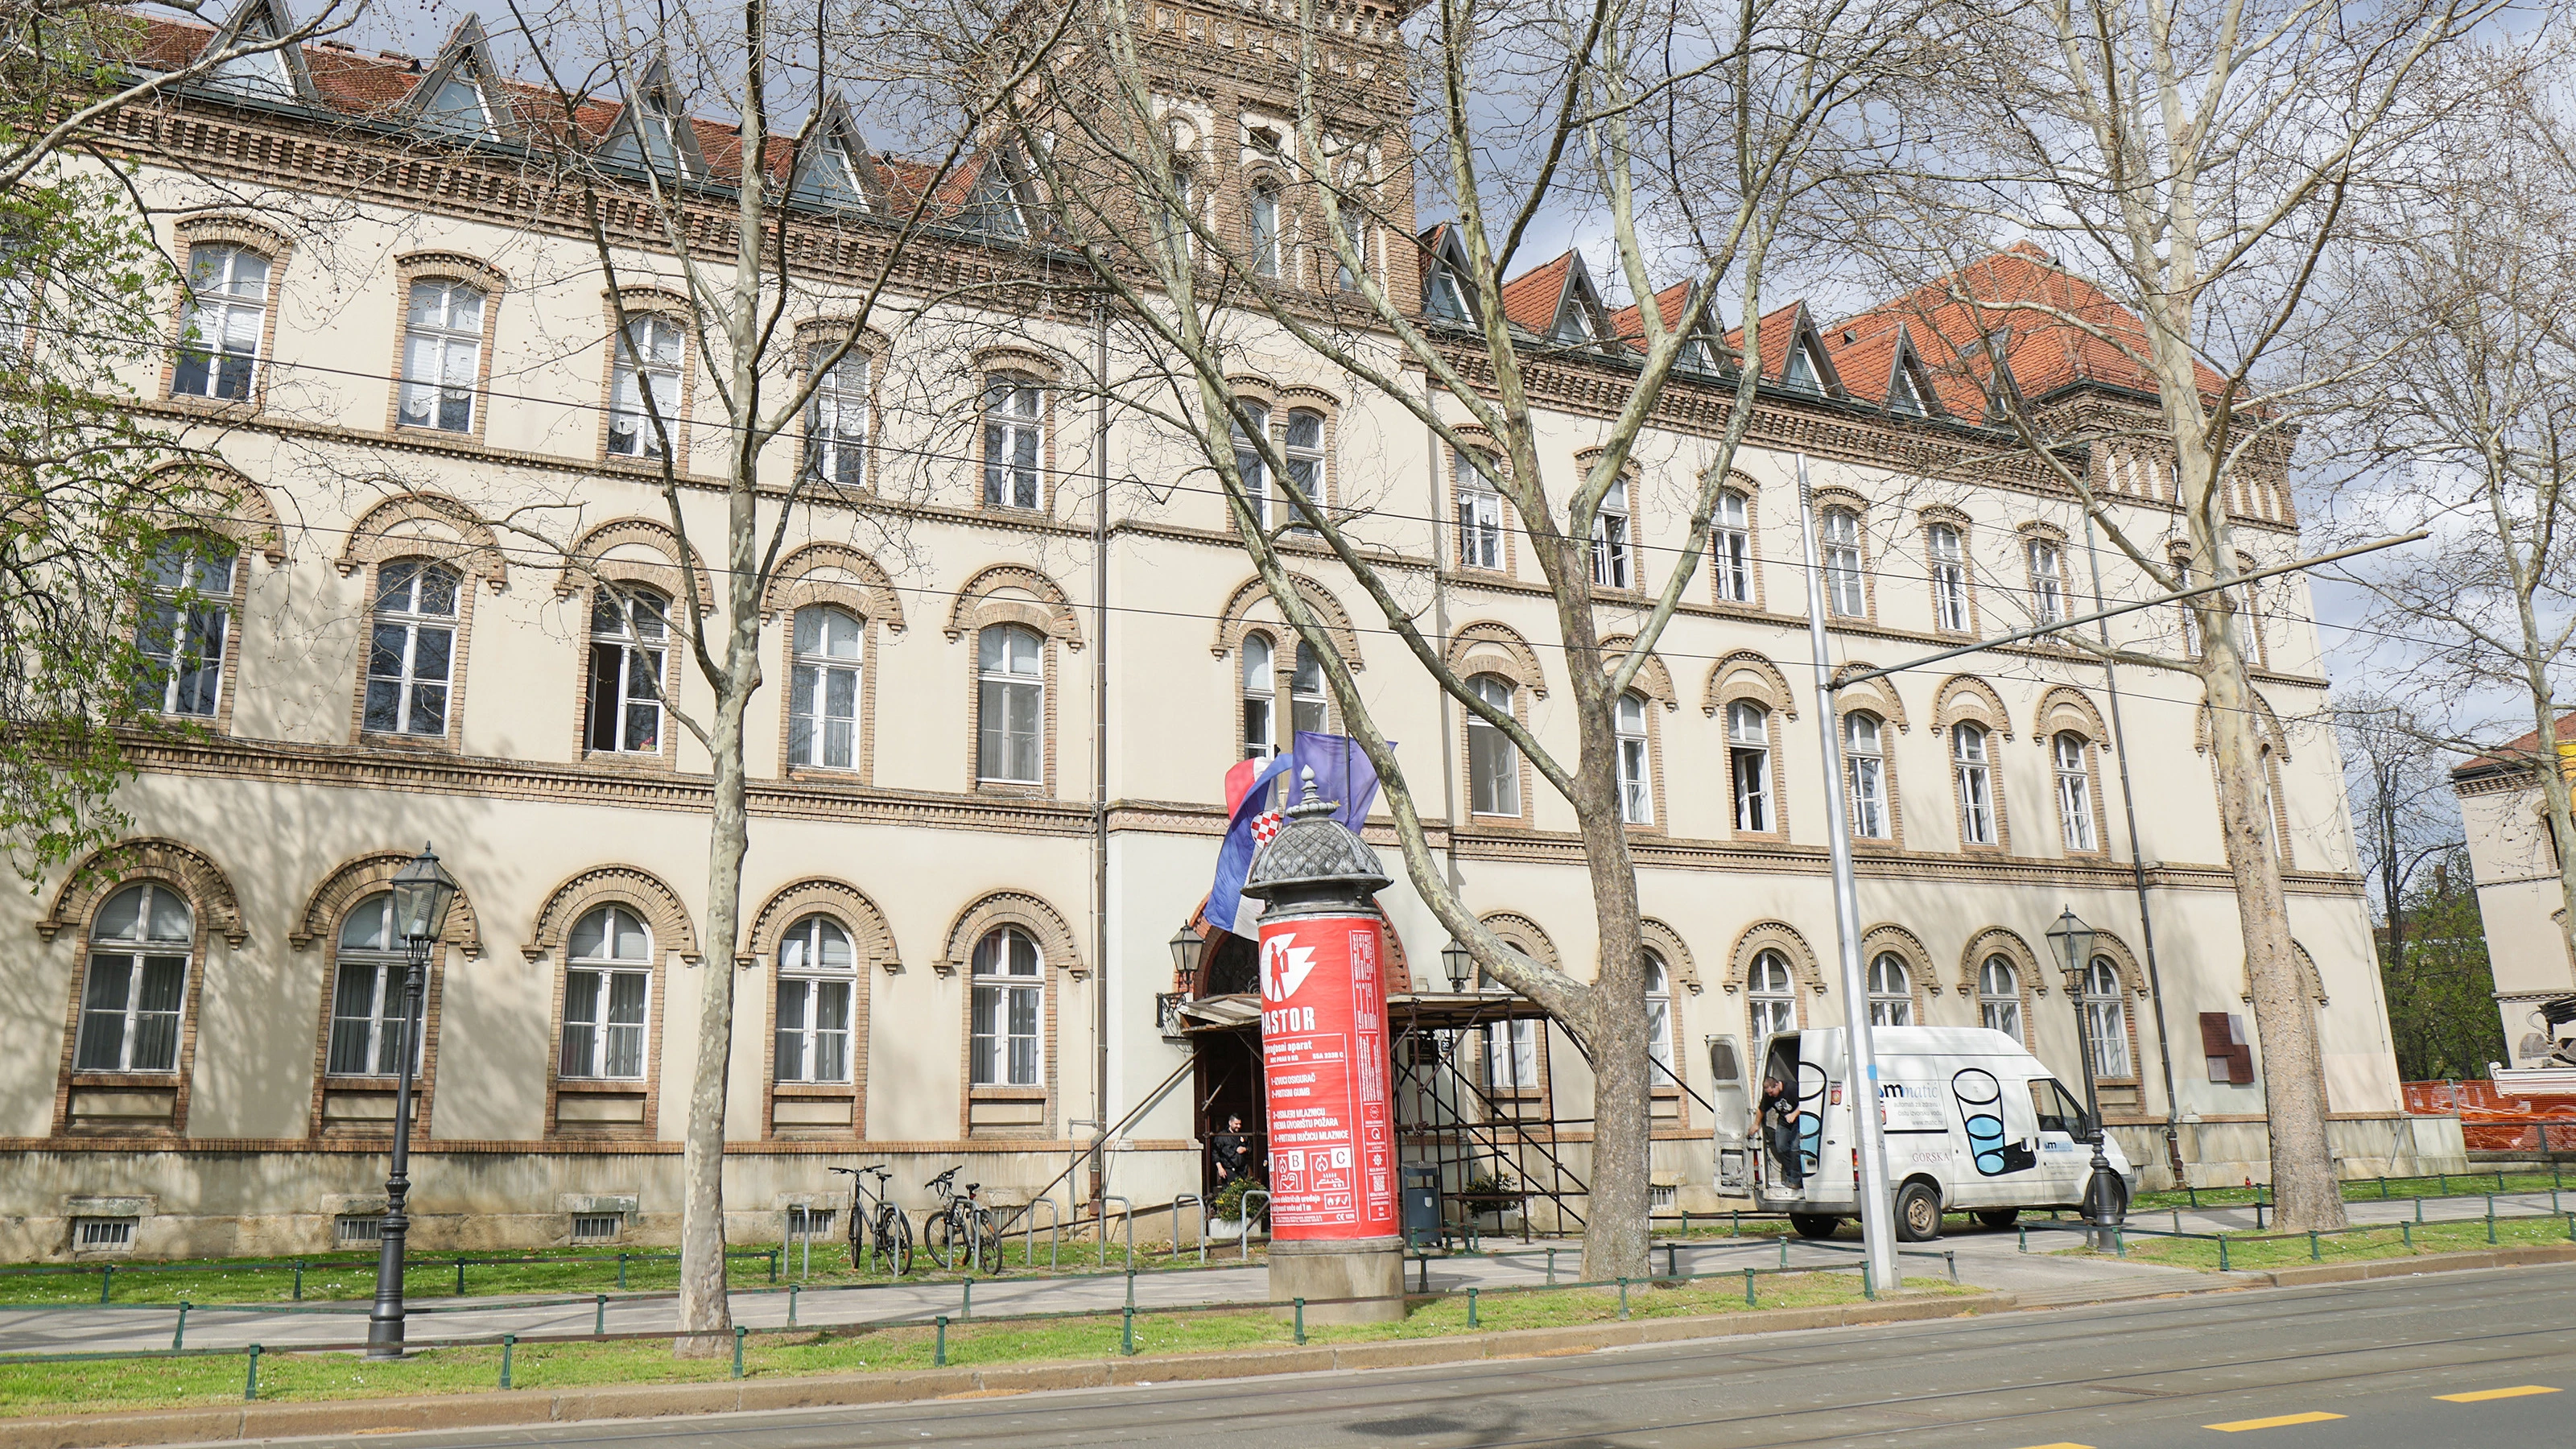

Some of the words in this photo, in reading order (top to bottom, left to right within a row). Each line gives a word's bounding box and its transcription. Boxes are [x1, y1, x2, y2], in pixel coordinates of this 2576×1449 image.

[1287, 1039, 1312, 1053] aparat
[1288, 1072, 1316, 1085] OSIGURAČ
[1293, 1087, 1311, 1096] GUMB
[1296, 1108, 1326, 1118] MLAZNICU
[1274, 1121, 1287, 1130] PREMA
[1287, 1117, 1313, 1129] IZVORIŠTU
[1314, 1117, 1339, 1128] POŽARA
[1297, 1130, 1319, 1142] RUČICU
[1319, 1129, 1349, 1141] MLAZNICE
[1292, 1154, 1299, 1167] B
[1336, 1151, 1345, 1164] C
[1912, 1152, 1950, 1163] GORSKA
